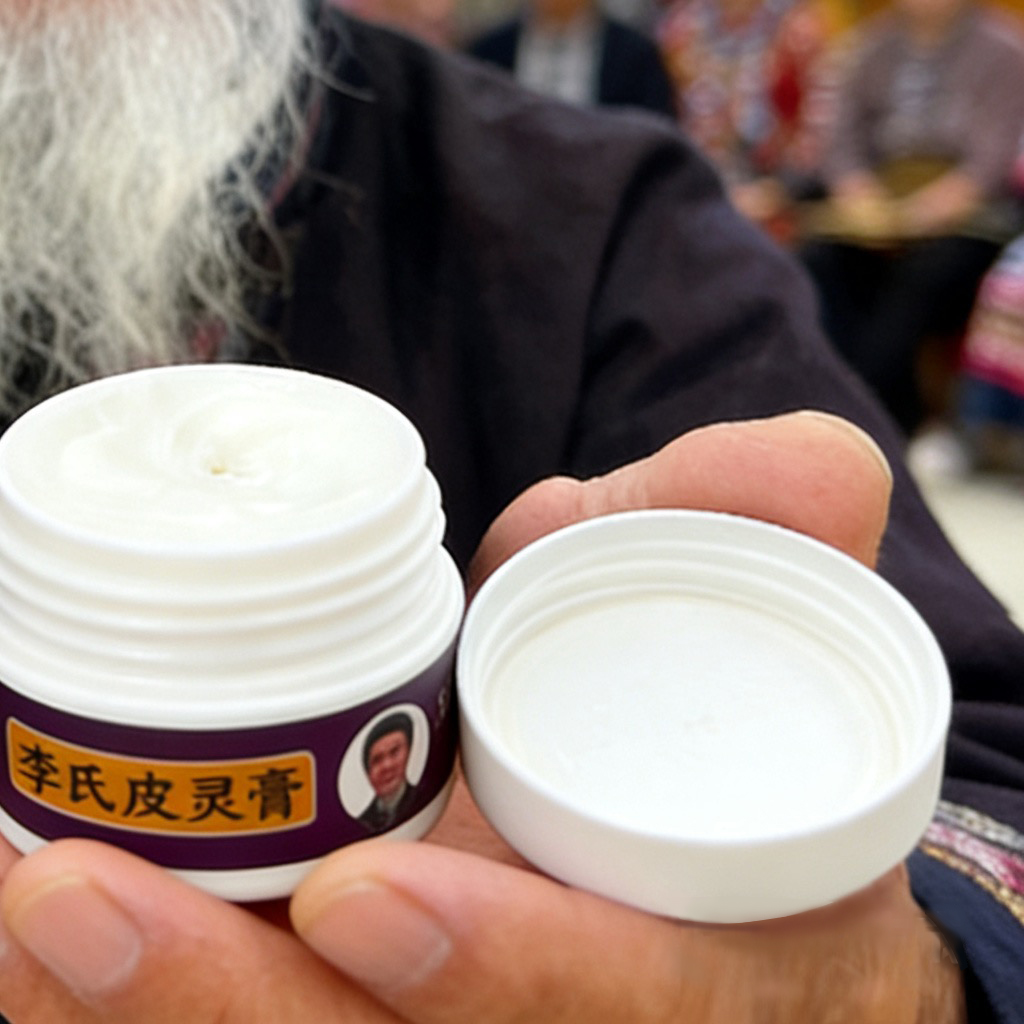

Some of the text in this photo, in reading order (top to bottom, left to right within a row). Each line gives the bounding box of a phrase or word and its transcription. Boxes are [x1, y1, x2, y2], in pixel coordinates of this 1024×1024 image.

[17, 741, 304, 823] 李氏皮灵膏
